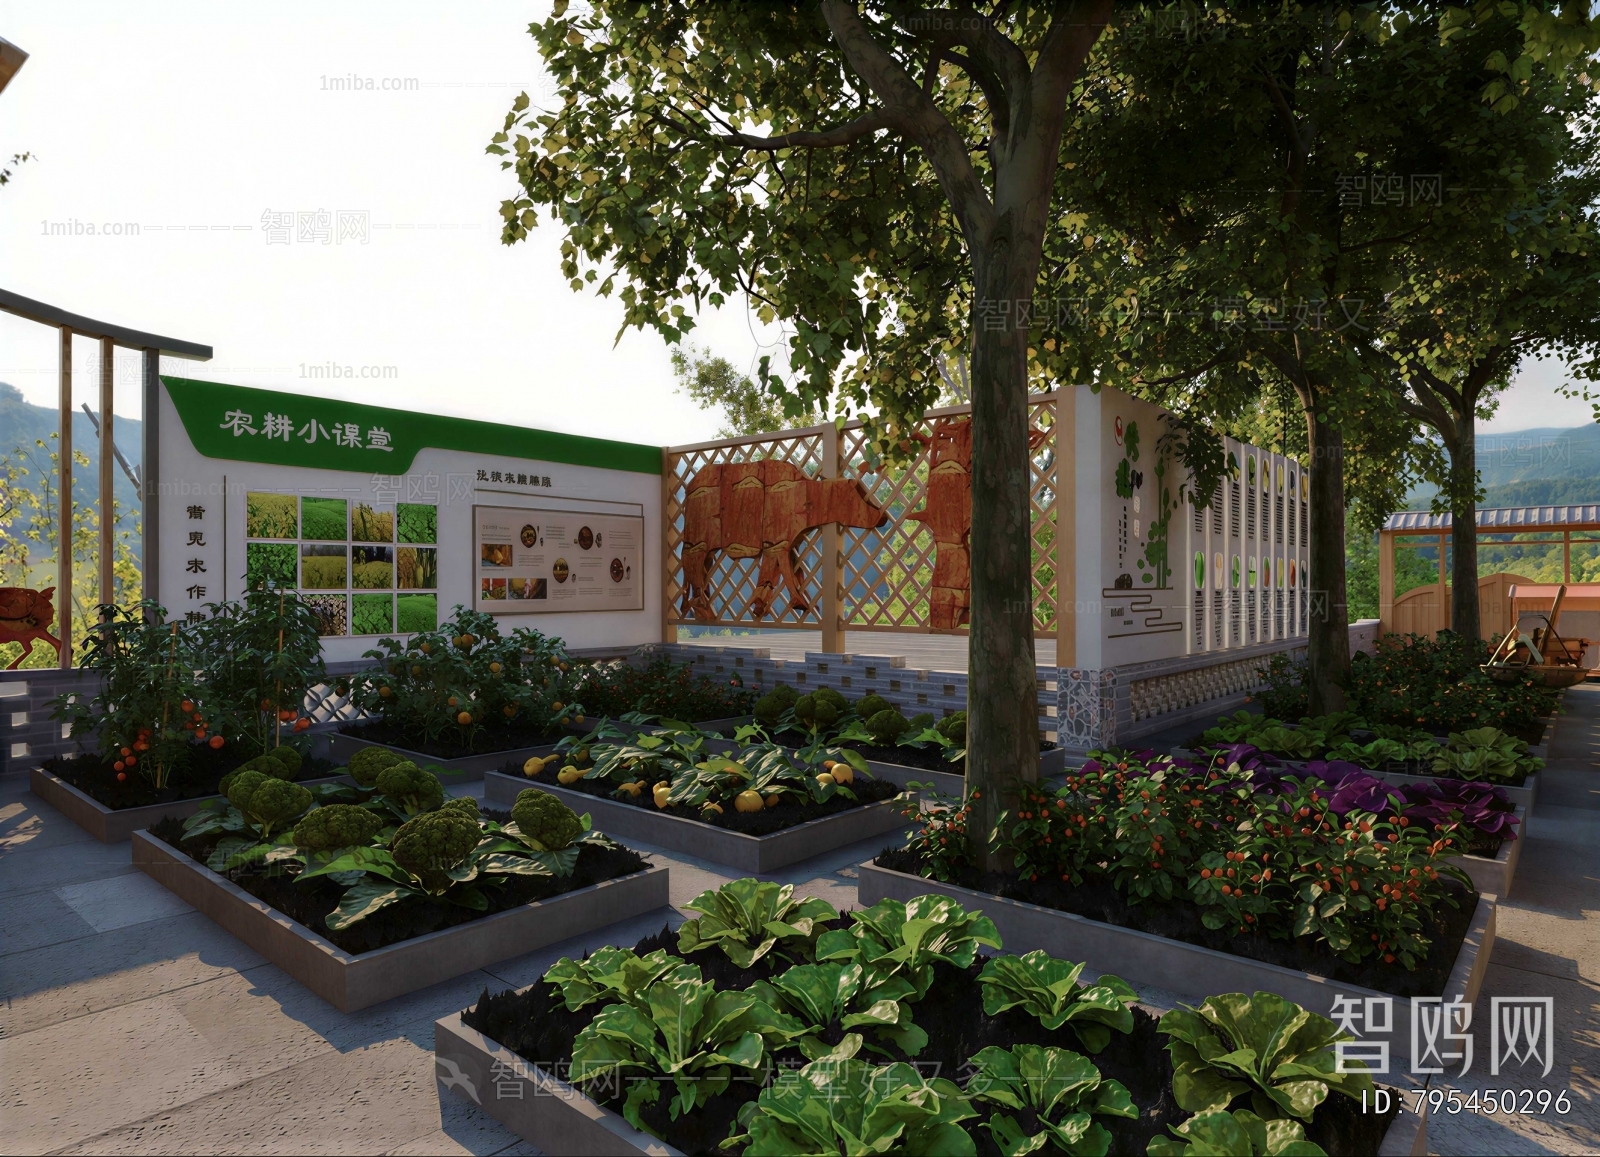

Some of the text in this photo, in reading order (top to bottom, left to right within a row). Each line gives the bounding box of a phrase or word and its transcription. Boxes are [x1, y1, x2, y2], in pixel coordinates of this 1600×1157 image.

[219, 408, 395, 453] 农耕小课堂
